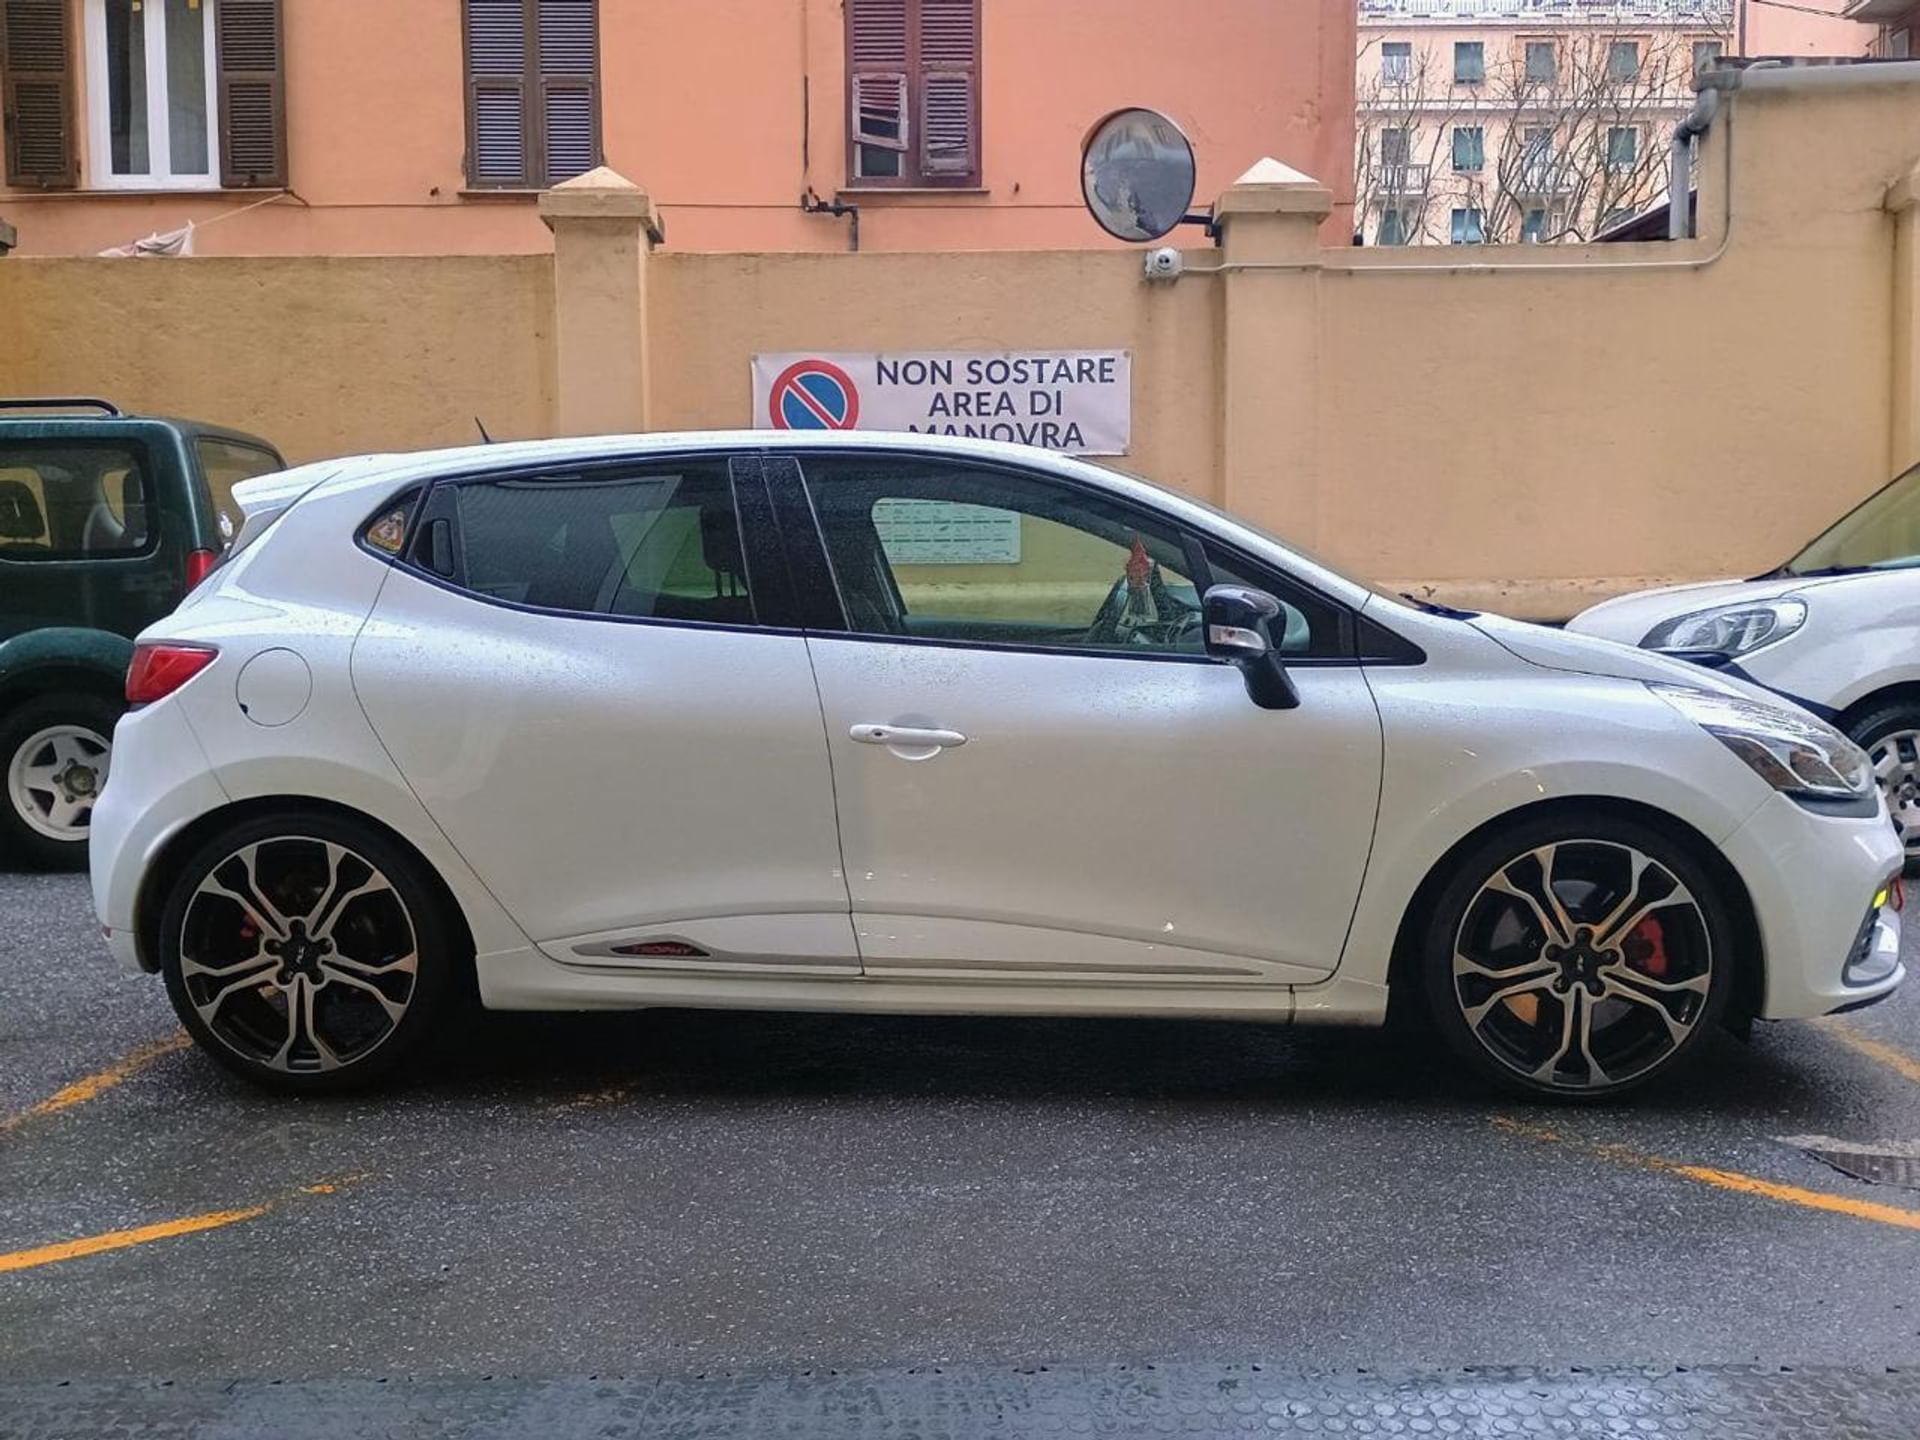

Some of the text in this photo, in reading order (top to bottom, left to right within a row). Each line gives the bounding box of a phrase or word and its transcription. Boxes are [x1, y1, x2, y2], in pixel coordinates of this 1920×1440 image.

[877, 358, 1115, 385] NON SOSTARE
[928, 390, 1062, 417] AREA DI
